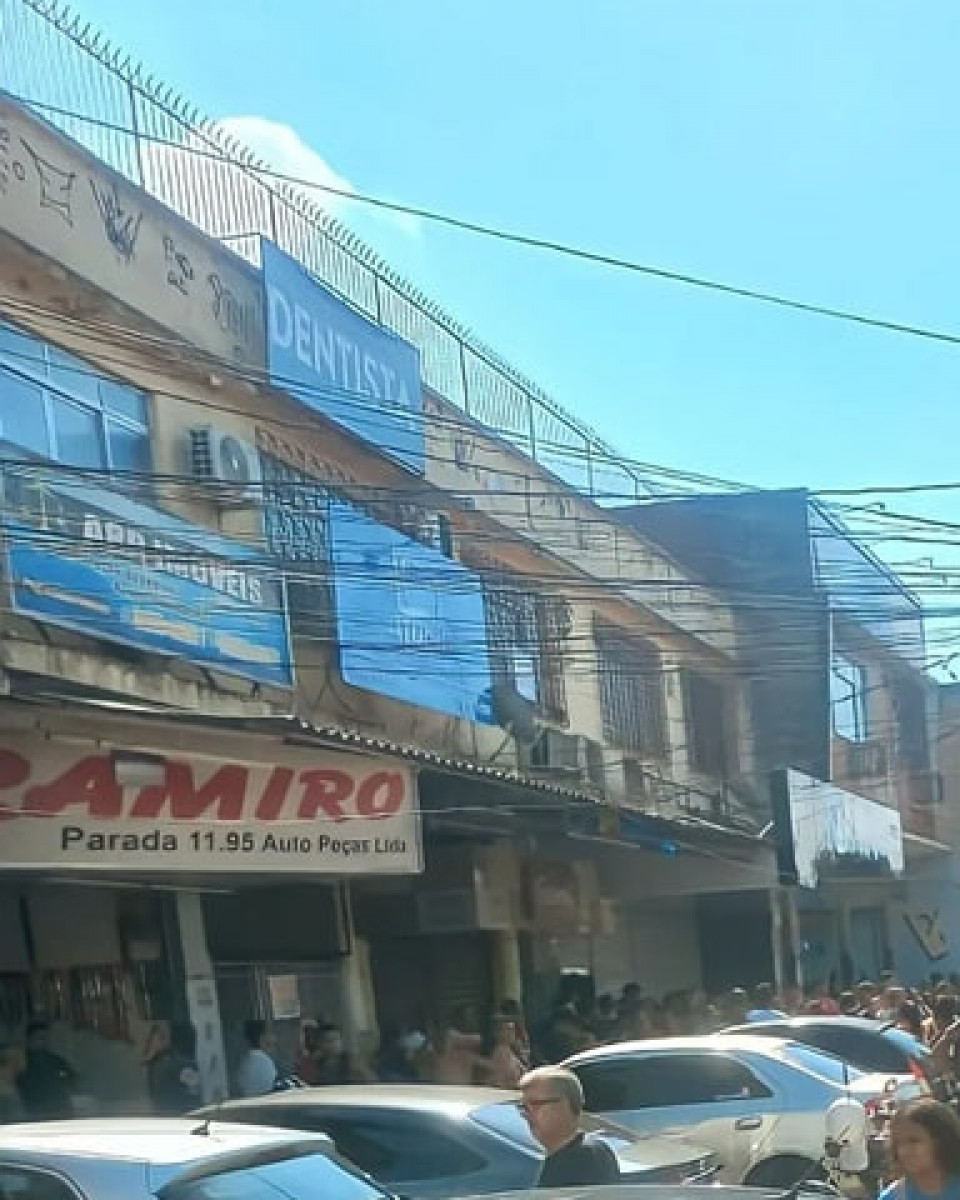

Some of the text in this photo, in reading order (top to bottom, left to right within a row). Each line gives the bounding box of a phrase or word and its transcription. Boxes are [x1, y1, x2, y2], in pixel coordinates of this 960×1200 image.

[60, 826, 178, 852] Parada
[189, 831, 254, 852] 11.95
[260, 833, 312, 853] Auto
[319, 834, 371, 857] Peças
